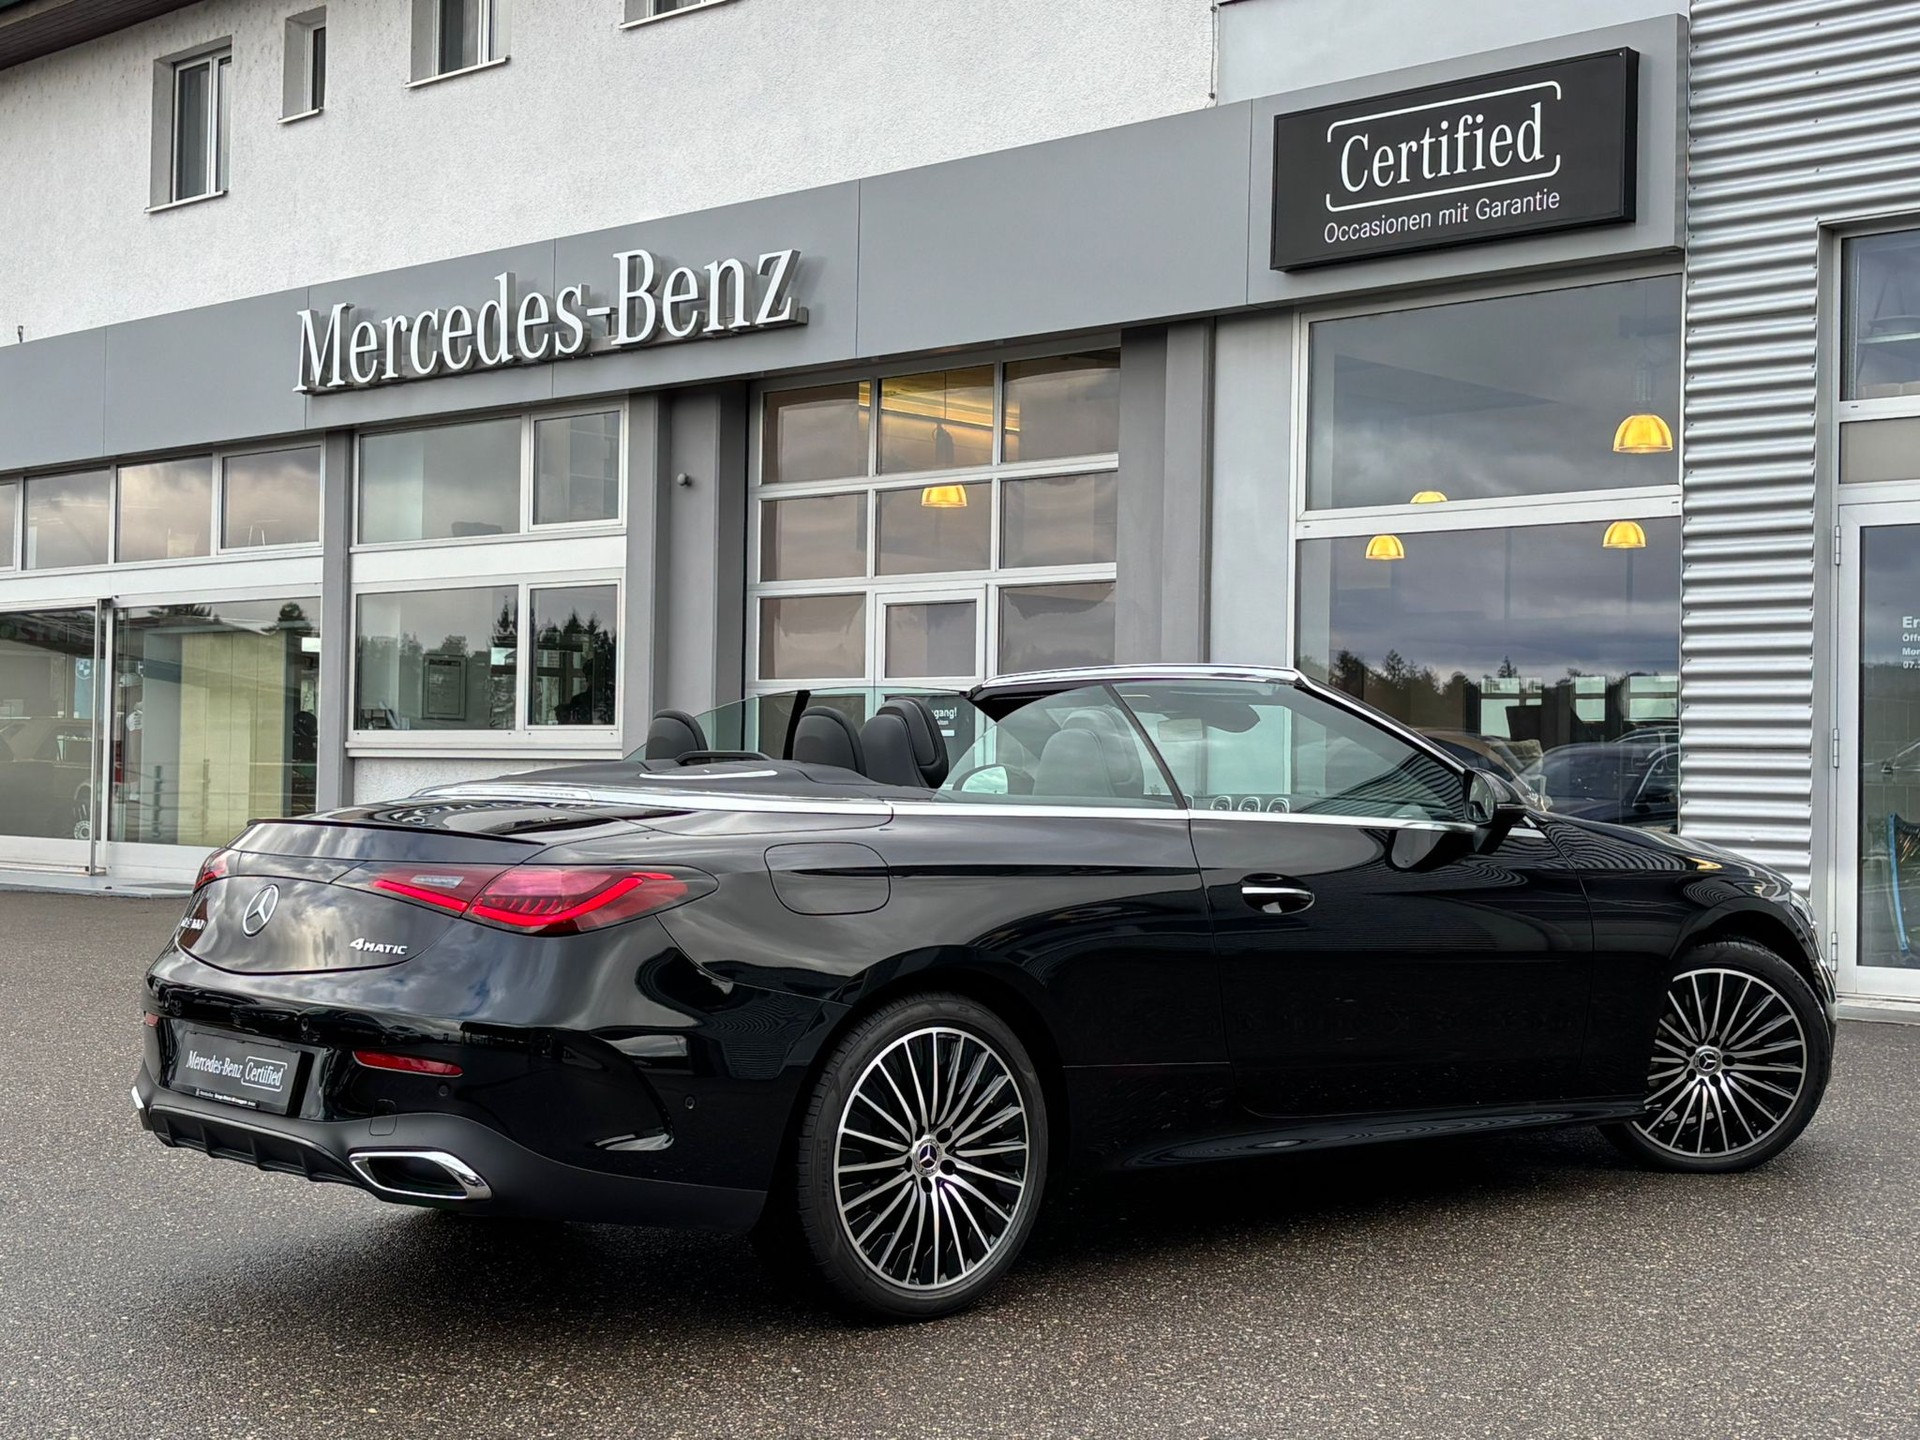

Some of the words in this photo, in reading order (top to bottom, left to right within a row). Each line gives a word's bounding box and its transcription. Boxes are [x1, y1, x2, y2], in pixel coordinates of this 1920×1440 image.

[1340, 101, 1545, 193] Certified
[1323, 210, 1432, 244] Occasionen
[1438, 202, 1469, 227] mit
[1474, 187, 1561, 221] Garantie
[292, 248, 802, 393] Mercedes-Benz
[1902, 615, 1920, 629] Er
[931, 706, 957, 720] gang!
[349, 937, 408, 955] 4MATIC
[185, 1049, 243, 1079] Mercedes-Benz
[244, 1061, 283, 1087] Certified
